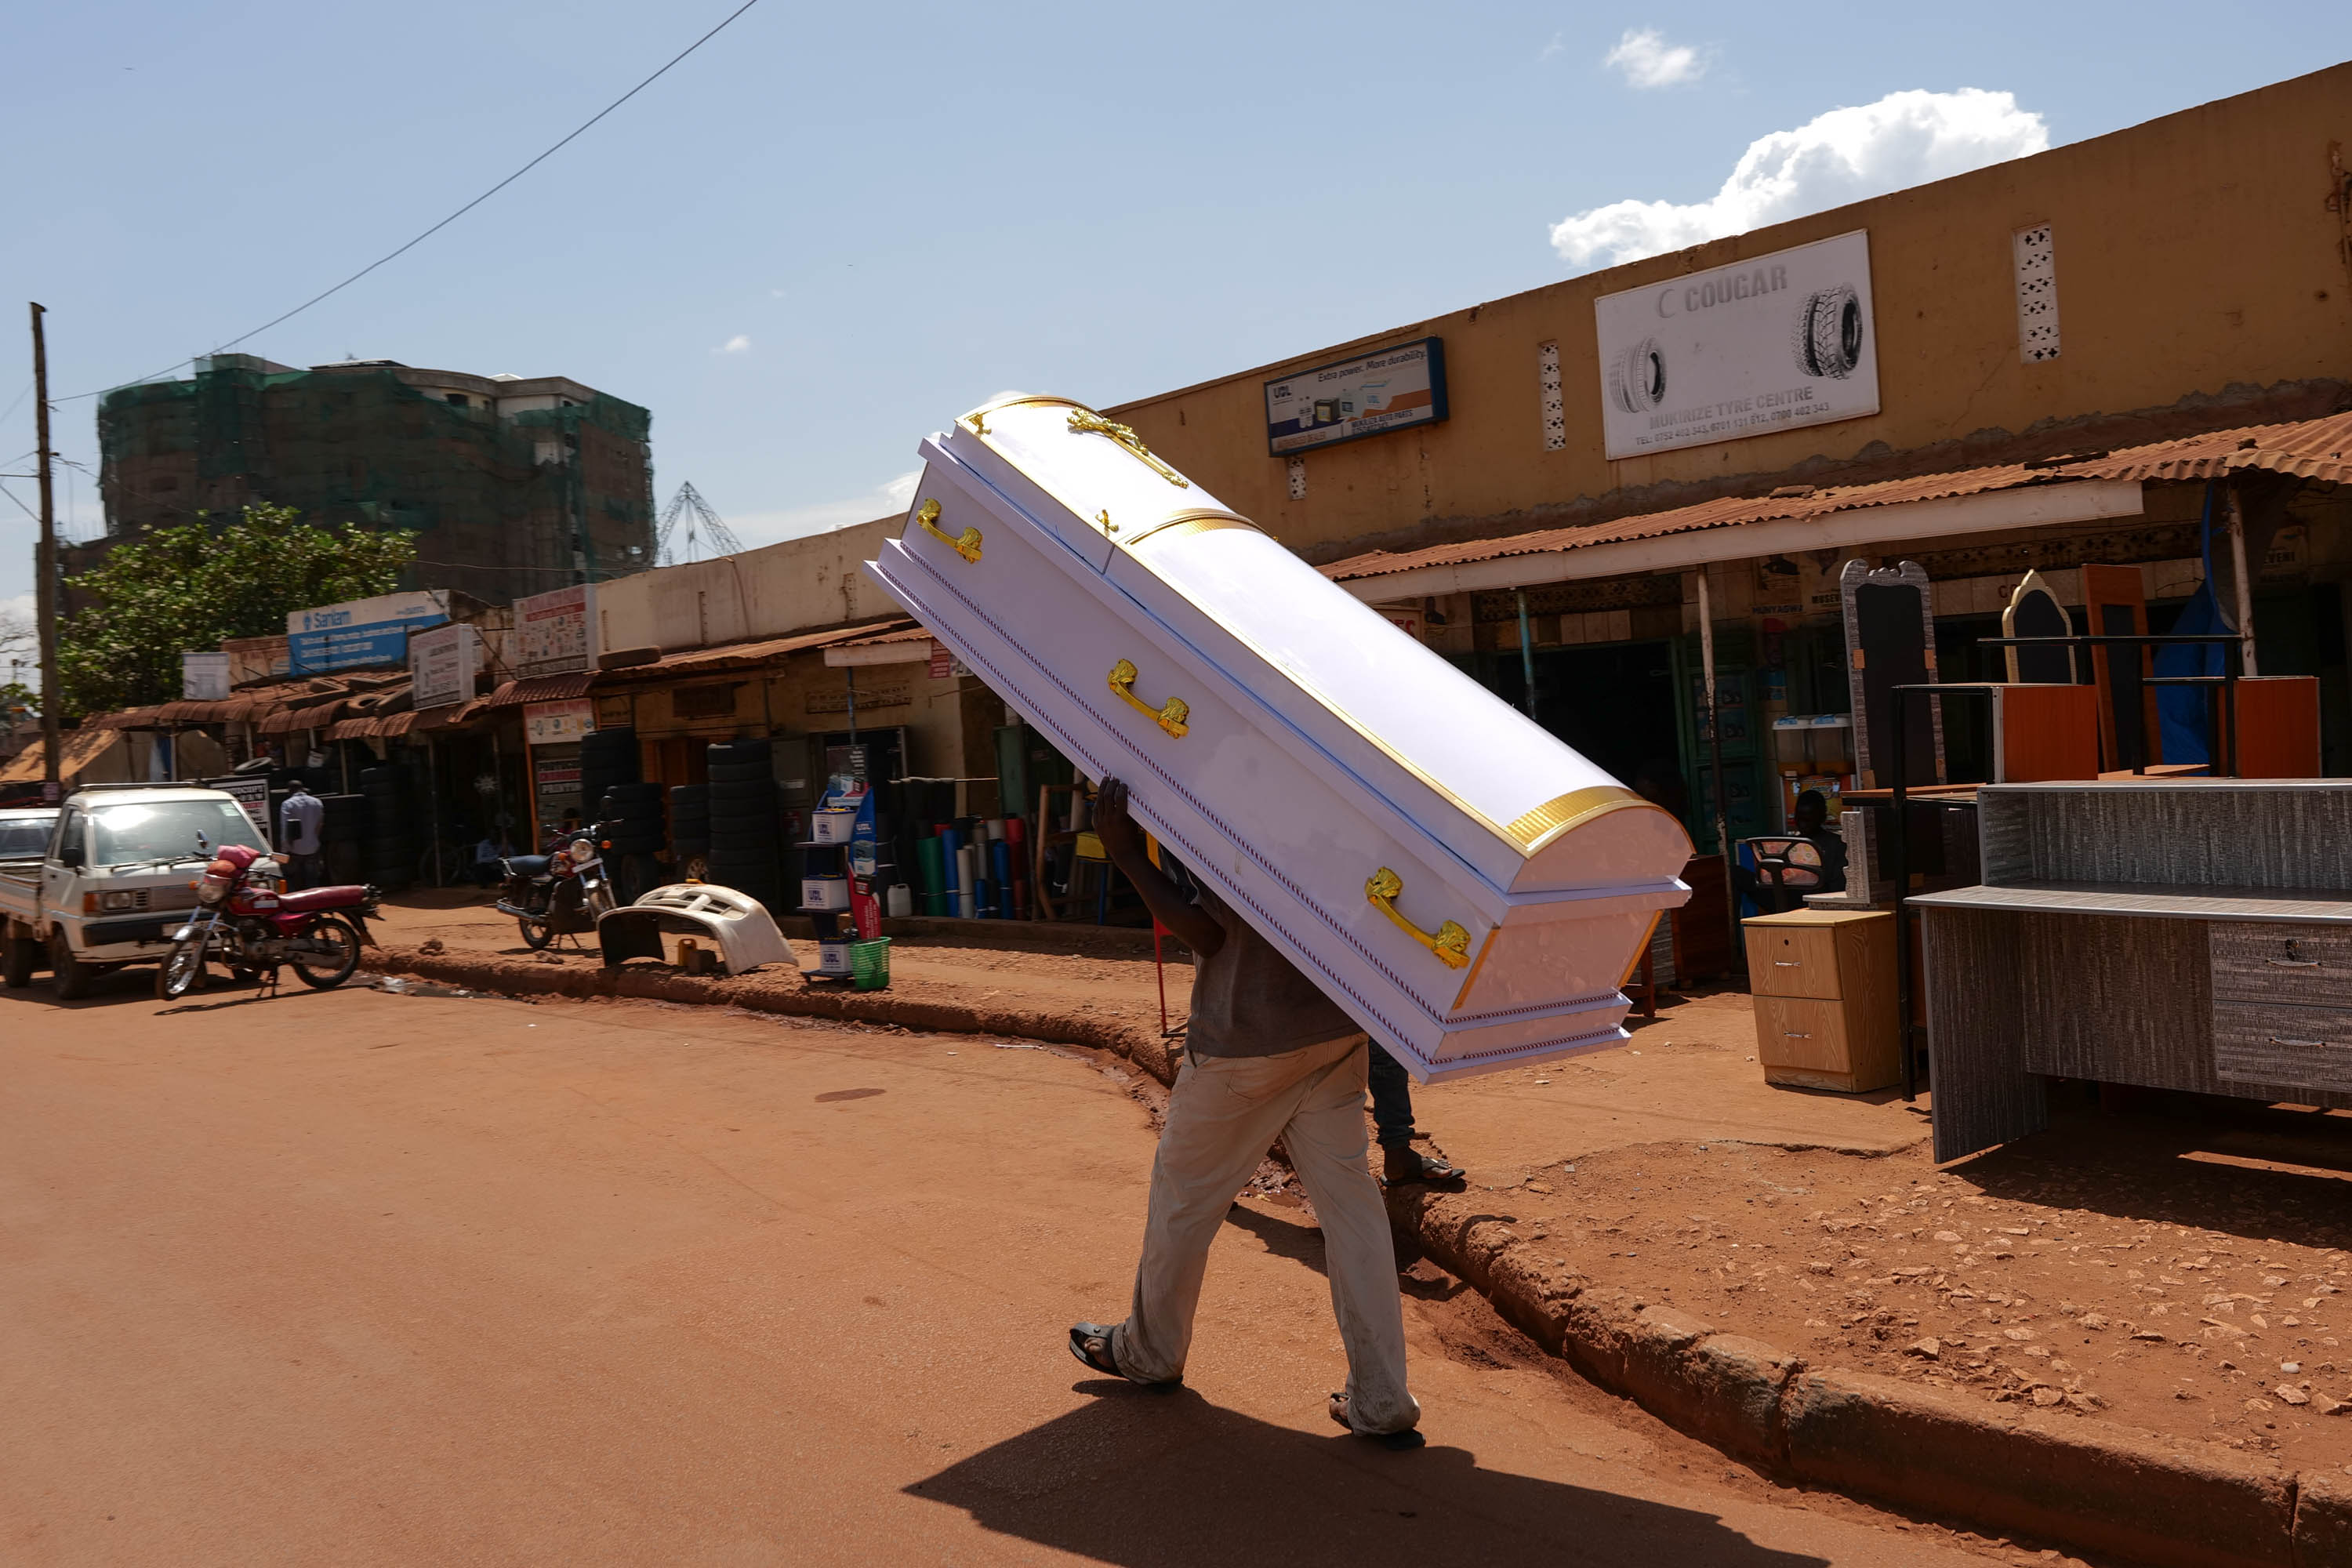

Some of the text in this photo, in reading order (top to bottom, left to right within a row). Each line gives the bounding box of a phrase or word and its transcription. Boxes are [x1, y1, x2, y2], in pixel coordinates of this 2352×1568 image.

[1685, 265, 1788, 312] COUGAR
[1318, 372, 1338, 383] Extra
[1339, 365, 1363, 378] power.
[1367, 358, 1386, 369] More
[1650, 387, 1813, 430] MUKIRIZE TYRE CENTRE
[314, 609, 352, 629] Sanlam
